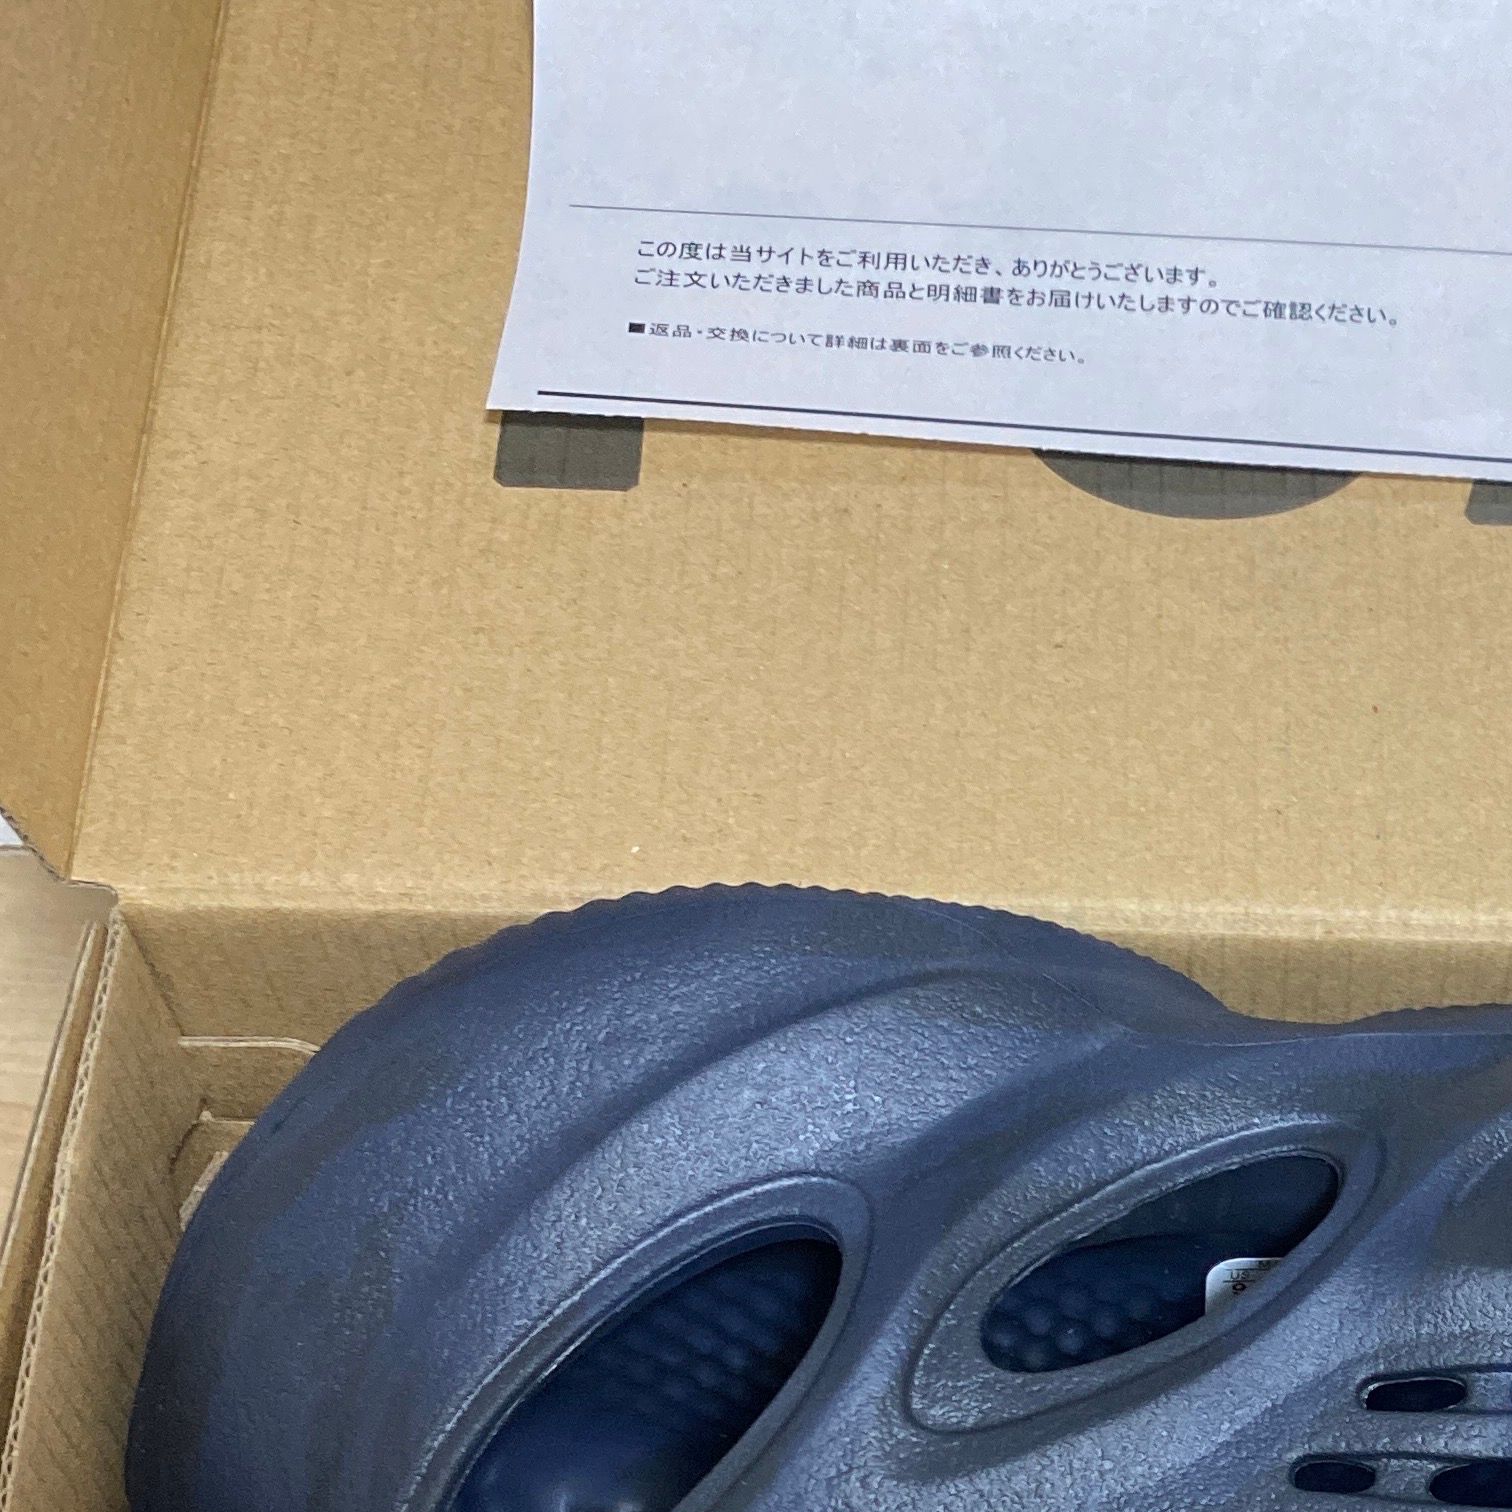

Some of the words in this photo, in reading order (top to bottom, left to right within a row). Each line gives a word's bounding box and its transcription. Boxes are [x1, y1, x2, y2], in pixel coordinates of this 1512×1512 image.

[637, 240, 1218, 288] この度は当サイトをご利用いただき、ありがとうございます。
[633, 267, 1400, 327] ご注文いただきました商品と明細書をお届けいたしますのでご確認ください。
